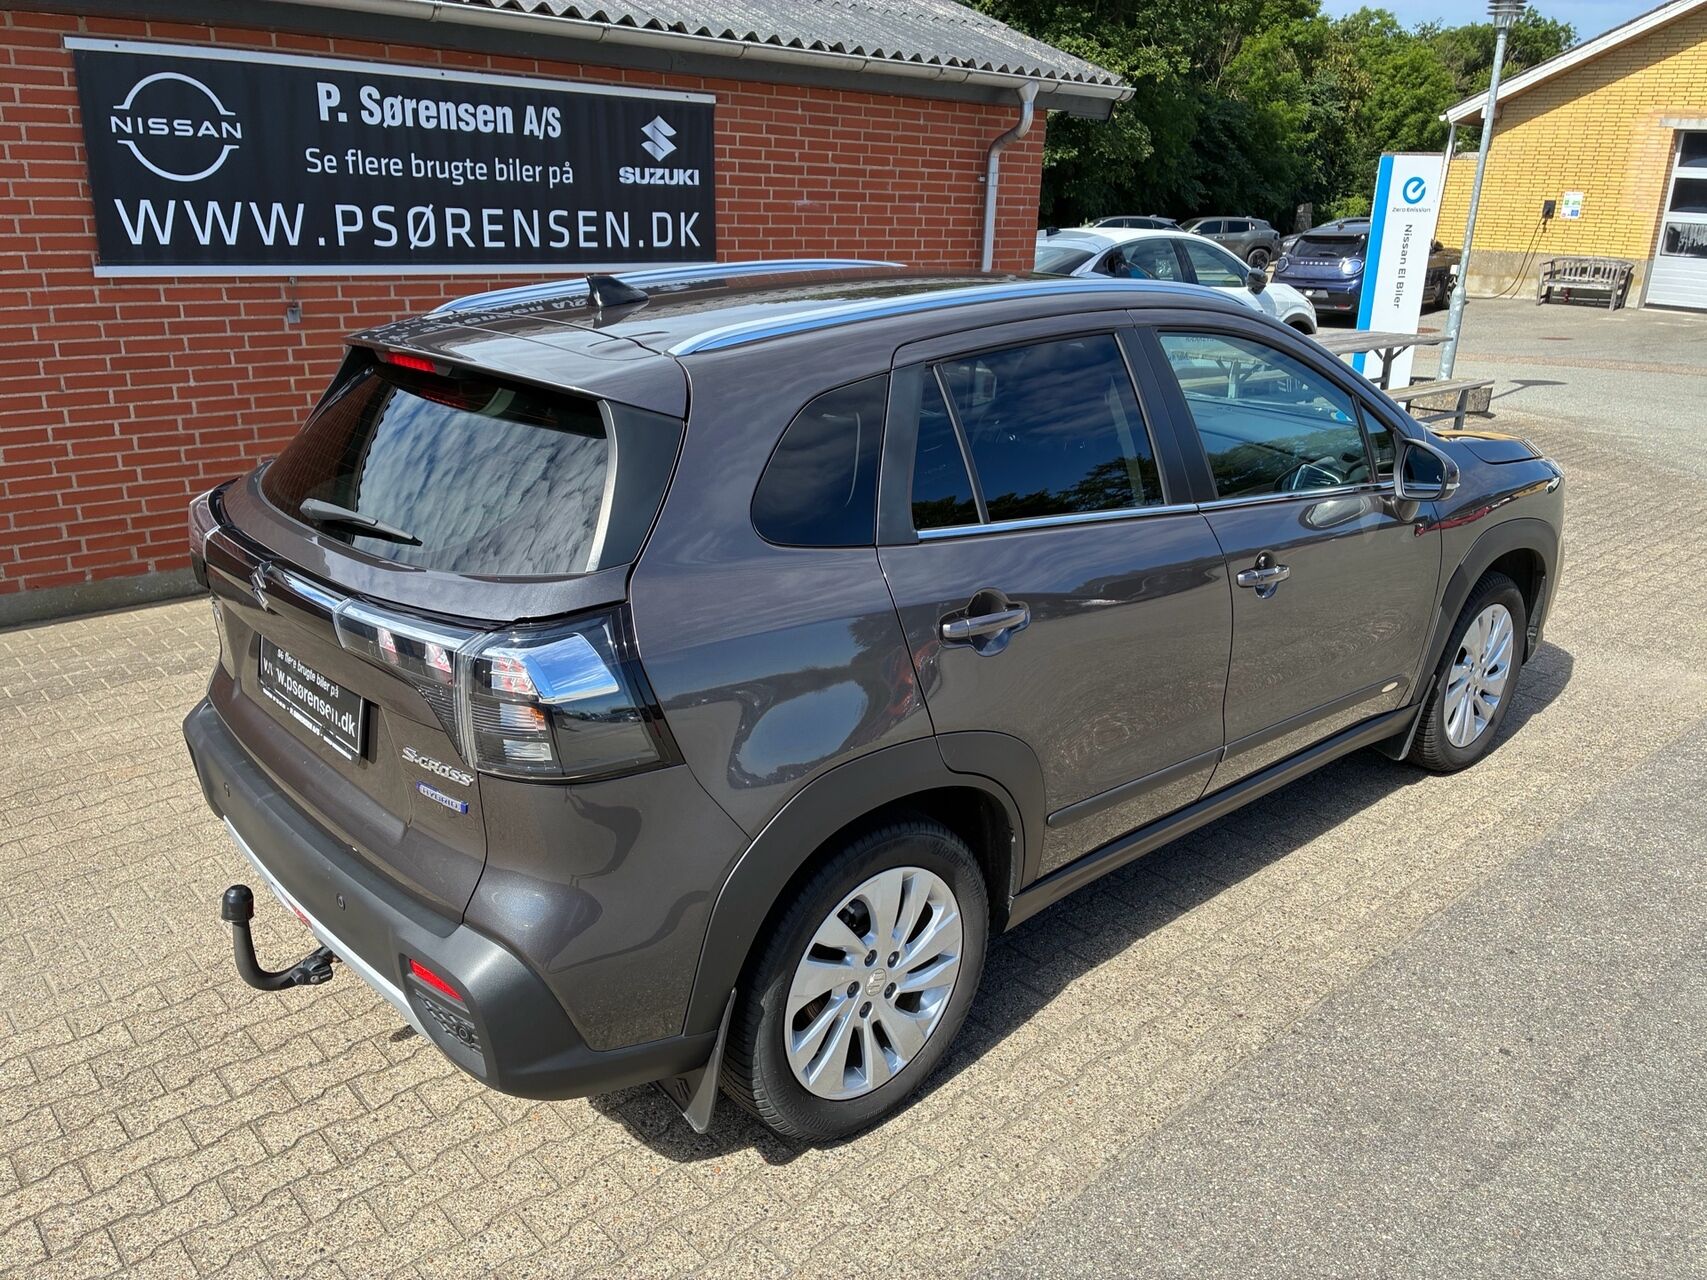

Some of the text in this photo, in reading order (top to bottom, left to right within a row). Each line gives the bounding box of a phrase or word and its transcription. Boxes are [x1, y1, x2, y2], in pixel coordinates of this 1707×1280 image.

[110, 115, 242, 139] NISSAN
[316, 81, 562, 140] P. Sørensen A/S
[305, 147, 574, 189] Se flere brugte biler på
[618, 166, 700, 186] SUZUKI
[113, 198, 701, 250] WWW.PSØRENSEN.DK
[1393, 224, 1413, 309] Nissan El Biler
[285, 652, 297, 669] flere
[297, 660, 316, 682] brugte
[316, 674, 330, 692] biler
[330, 684, 339, 699] på
